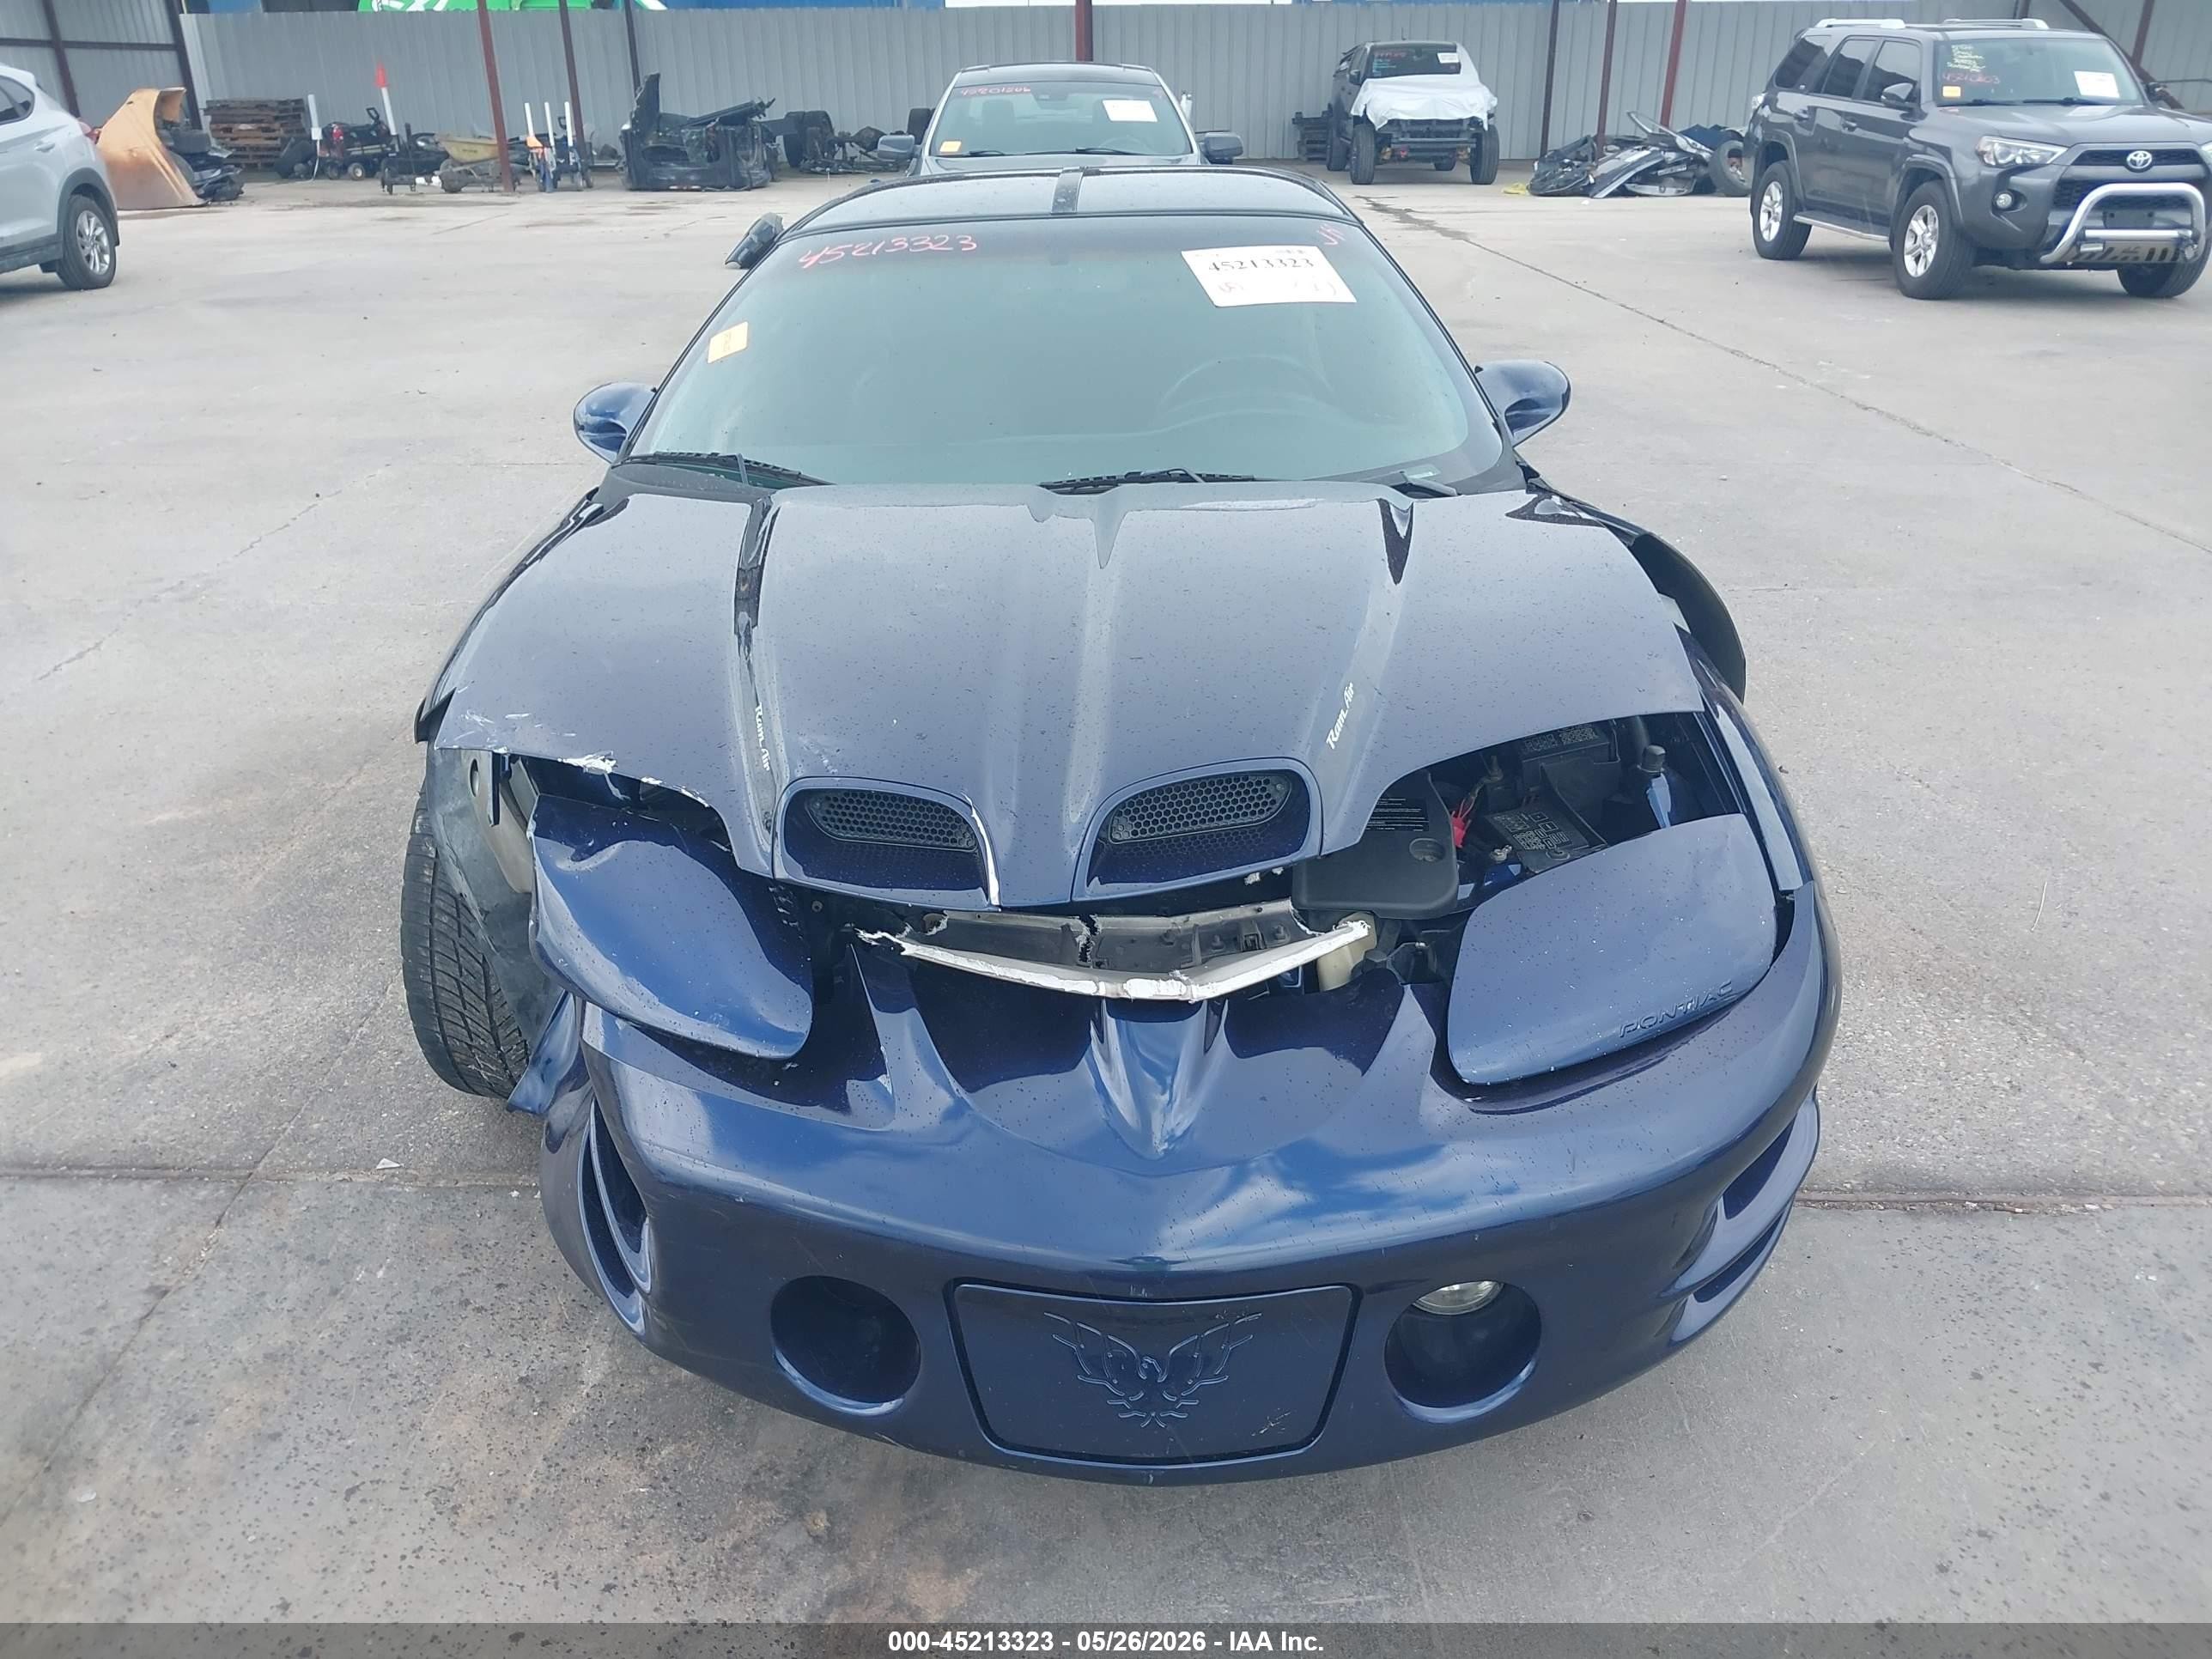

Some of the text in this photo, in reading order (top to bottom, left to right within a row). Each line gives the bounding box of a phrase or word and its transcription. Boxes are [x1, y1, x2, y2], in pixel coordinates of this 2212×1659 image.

[799, 234, 977, 269] 45213323
[1209, 258, 1314, 271] 45213323
[756, 702, 770, 770] Ram Air
[1326, 682, 1353, 749] Ram Air
[1620, 979, 1732, 1037] PONTIAC
